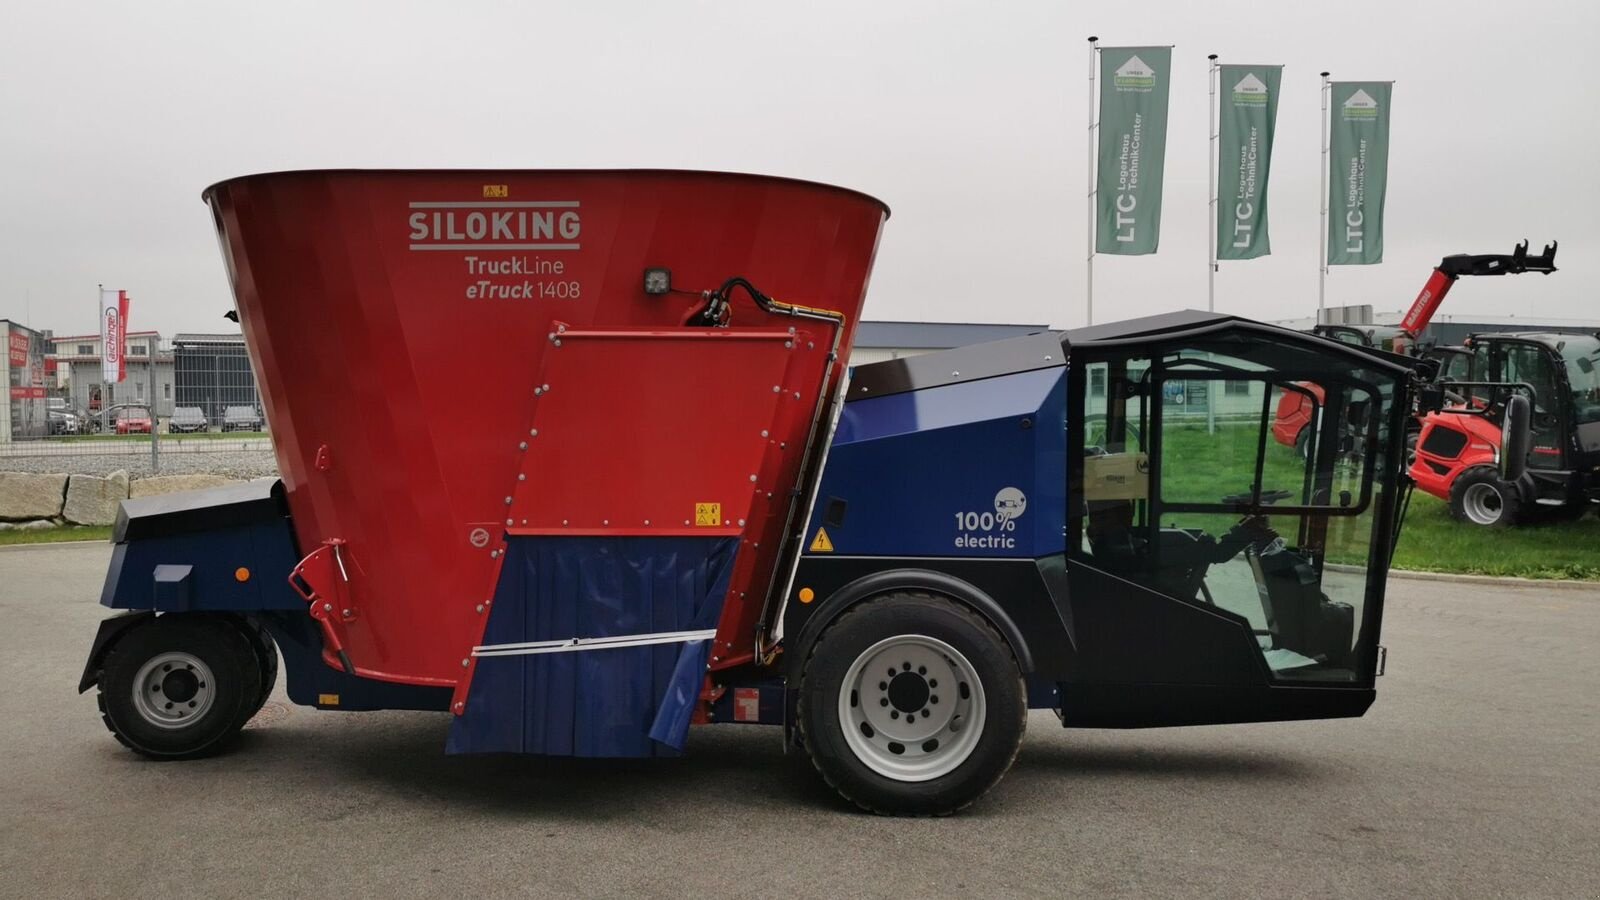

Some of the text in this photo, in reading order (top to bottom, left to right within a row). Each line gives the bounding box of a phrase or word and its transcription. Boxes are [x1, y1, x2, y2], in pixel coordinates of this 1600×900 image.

[1117, 133, 1131, 191] Lagerhaus
[1128, 112, 1142, 191] TechnikCenter
[1237, 145, 1247, 199] Lagerhaus
[1245, 126, 1257, 199] TechnikCenter
[1347, 156, 1358, 208] Lagerhaus
[409, 211, 580, 240] SILOKING
[1116, 194, 1137, 242] LTC
[1233, 202, 1253, 248] LTC
[1346, 210, 1364, 253] LTC
[465, 256, 564, 274] TruckLine
[466, 281, 580, 299] eTruck 1408
[954, 511, 1016, 532] 100%
[954, 533, 1016, 549] electric
